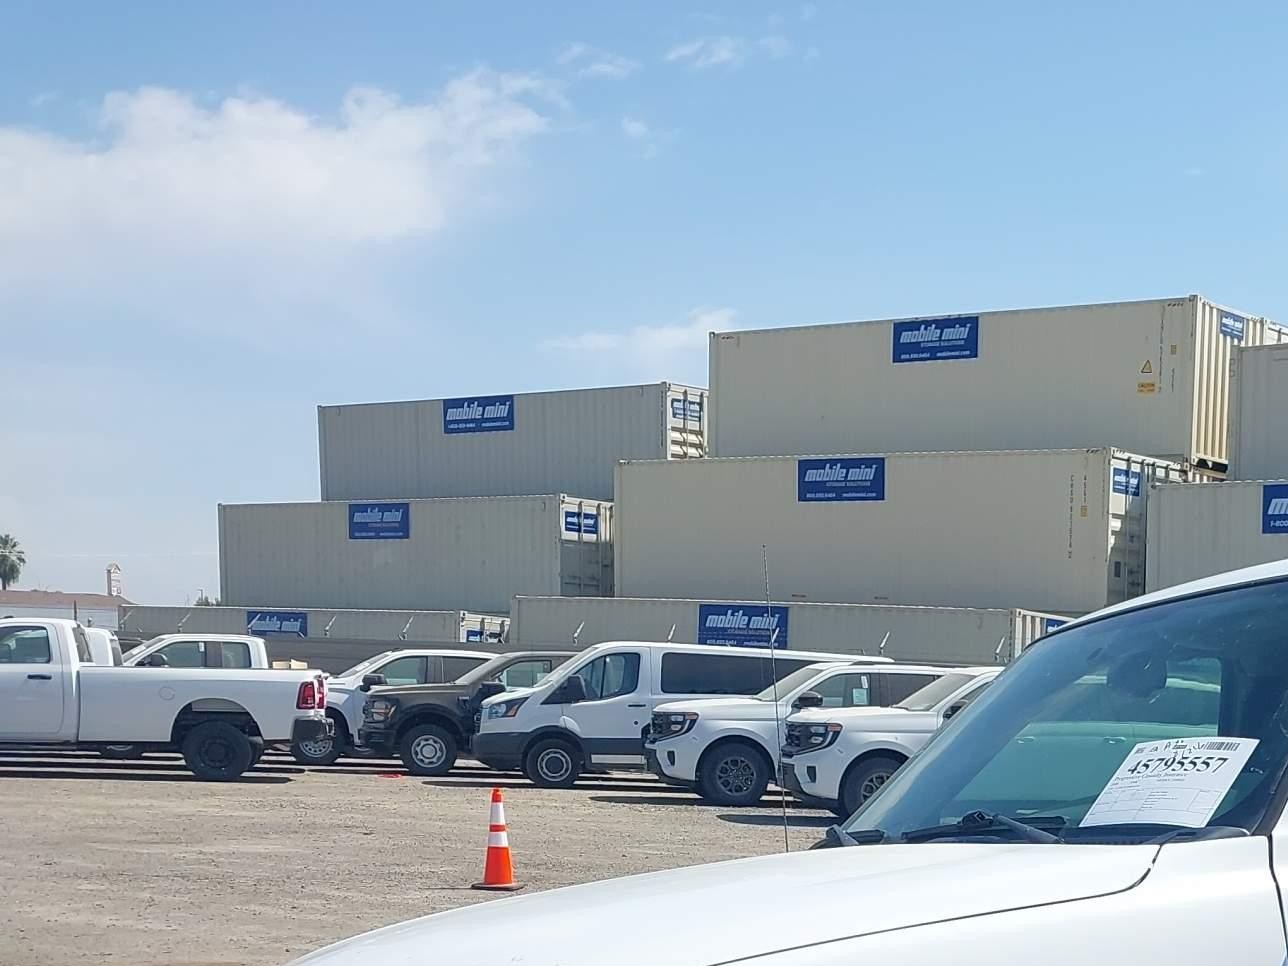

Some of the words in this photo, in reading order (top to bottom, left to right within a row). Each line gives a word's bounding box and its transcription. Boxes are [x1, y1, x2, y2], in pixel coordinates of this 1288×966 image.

[900, 324, 941, 343] mobile
[942, 323, 970, 340] mini
[446, 401, 483, 420] mobile
[484, 401, 510, 418] mini
[805, 463, 847, 481] mobile
[847, 465, 877, 480] mini
[705, 609, 749, 628] mobile
[749, 614, 779, 630] mini
[1127, 756, 1229, 774] 45795557
